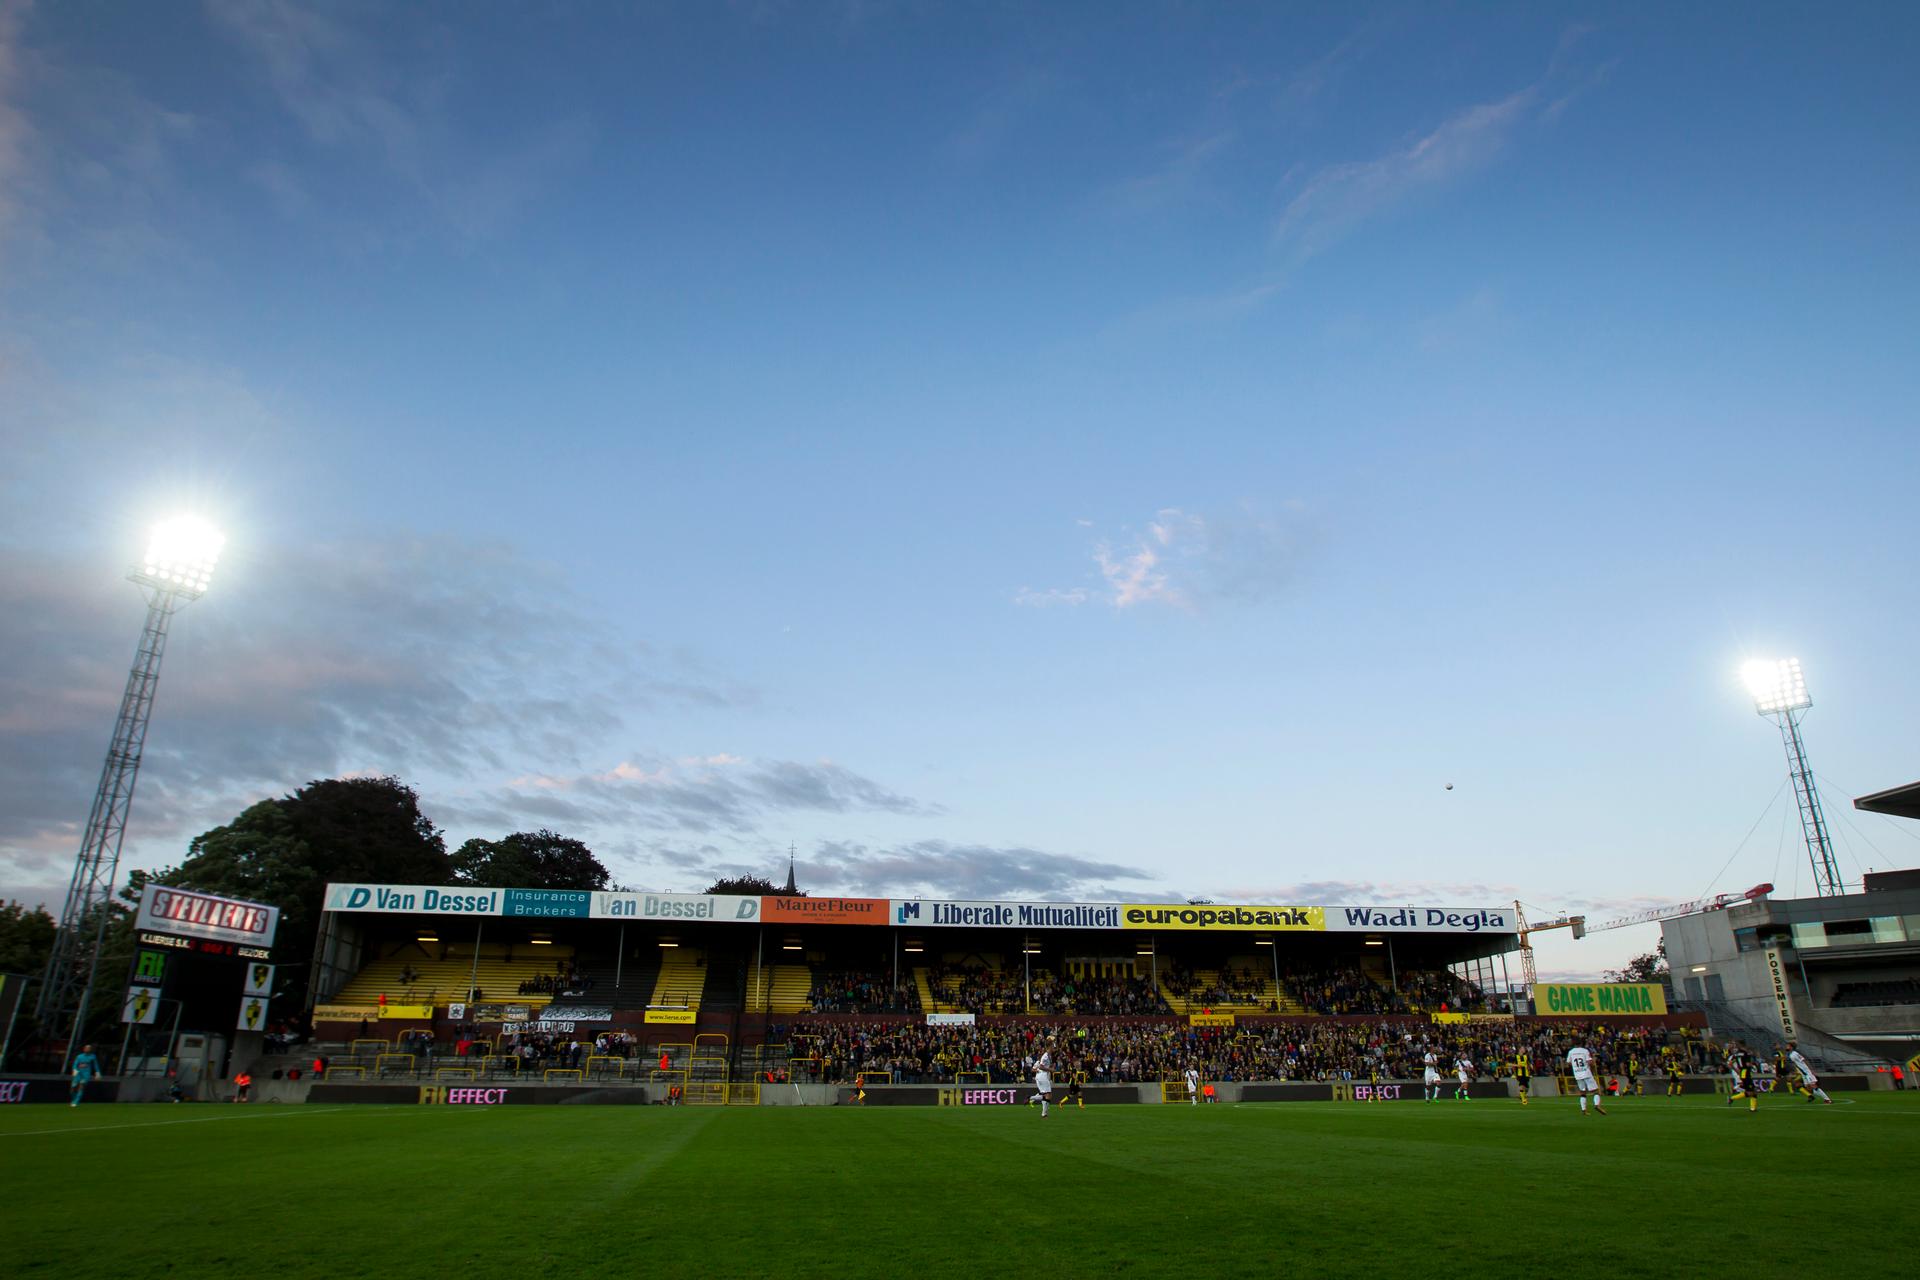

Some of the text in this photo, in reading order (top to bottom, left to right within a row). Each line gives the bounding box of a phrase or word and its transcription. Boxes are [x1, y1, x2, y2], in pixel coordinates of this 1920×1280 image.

[376, 888, 415, 910] Van
[424, 889, 496, 912] Dessel
[511, 890, 585, 903] Insurance
[600, 895, 636, 915] Van
[645, 897, 714, 918] Dessel
[776, 899, 874, 912] MarieFleur
[152, 892, 268, 932] STEYLAERTS
[515, 905, 576, 917] Brokers
[933, 904, 1118, 927] Liberale Mutualiteit
[1127, 908, 1309, 927] europabank
[1345, 908, 1504, 932] Wadi Degla
[1548, 986, 1653, 1012] GAME MANIA
[1768, 953, 1793, 1034] POSSEMIERS
[1574, 1058, 1585, 1067] 13
[449, 1087, 508, 1105] EFFECT
[965, 1089, 1016, 1105] EFFECT
